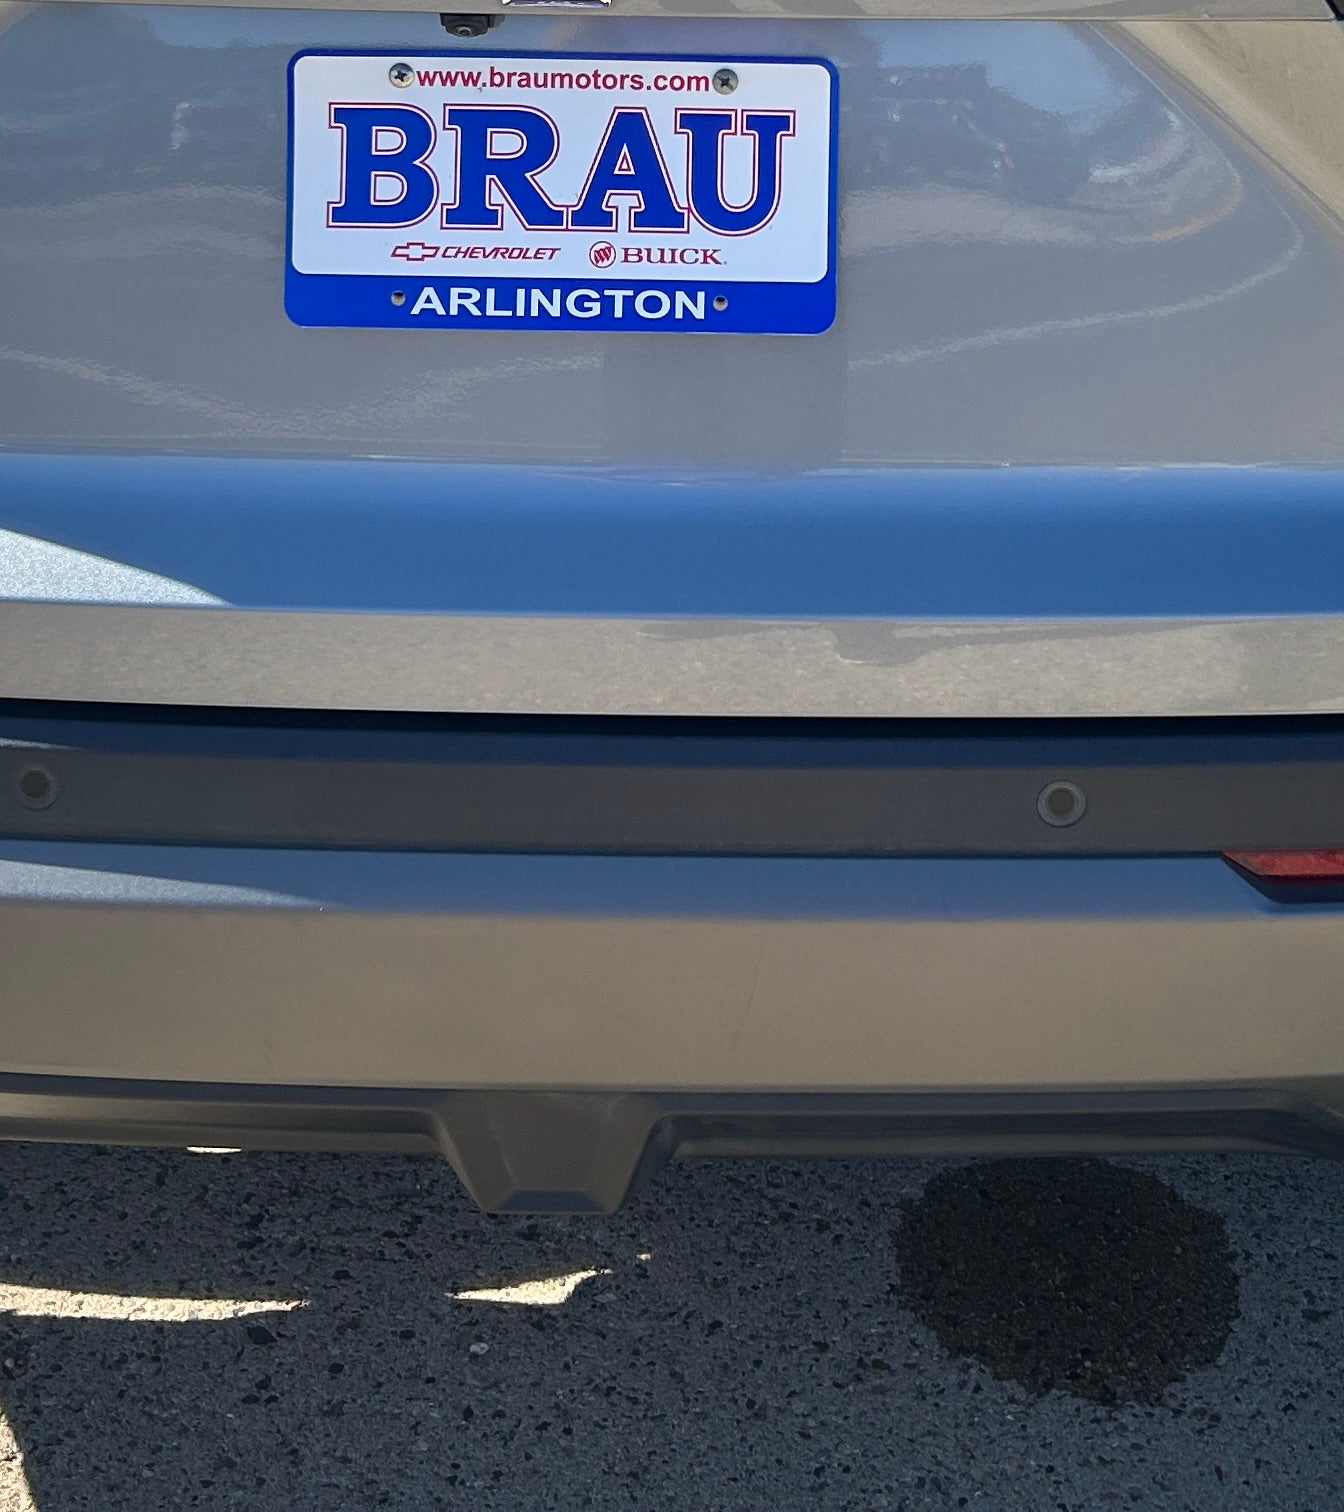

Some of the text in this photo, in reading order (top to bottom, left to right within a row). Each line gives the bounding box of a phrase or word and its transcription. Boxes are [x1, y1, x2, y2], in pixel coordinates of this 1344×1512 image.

[416, 66, 710, 92] www.braumotors.com
[326, 102, 795, 235] BRAU
[442, 244, 561, 261] CHEVROLET
[620, 247, 722, 265] BUICK
[410, 287, 706, 319] ARLINGTON
